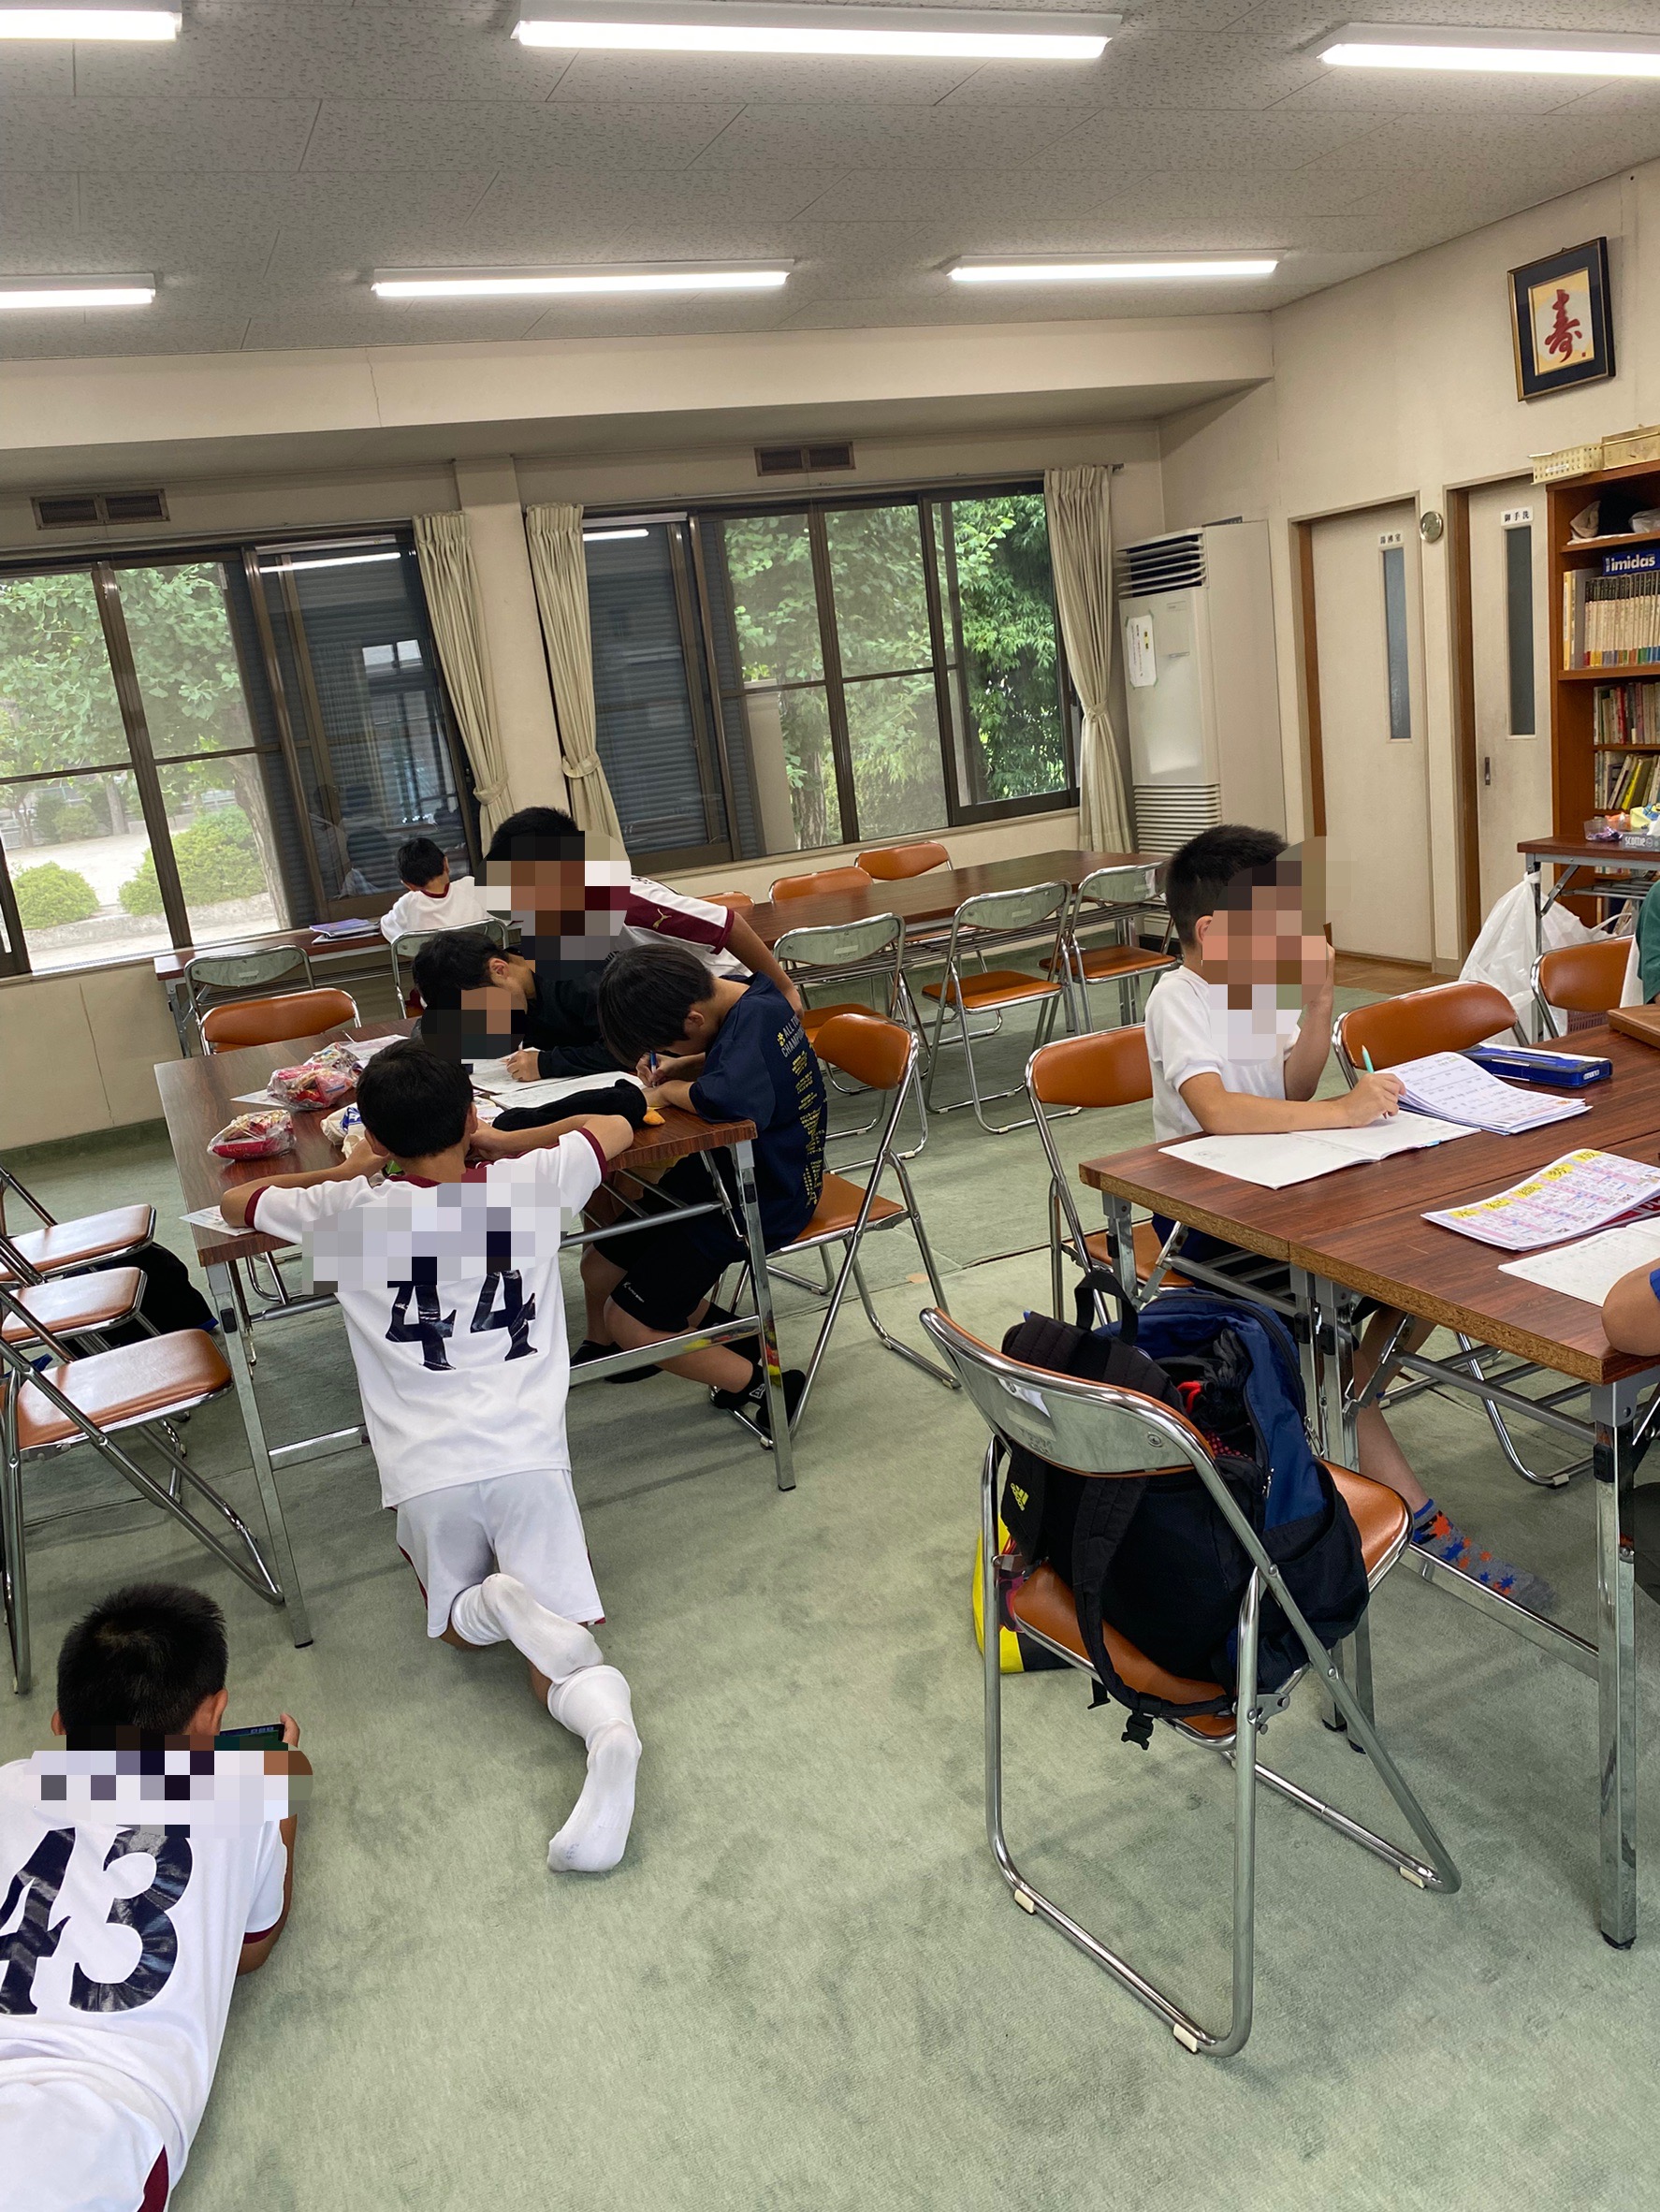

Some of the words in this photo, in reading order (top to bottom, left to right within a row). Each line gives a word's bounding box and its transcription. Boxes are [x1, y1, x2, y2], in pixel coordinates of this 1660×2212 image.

[1545, 289, 1582, 363] 寿
[1611, 554, 1655, 572] imidas
[386, 1254, 538, 1371] 44
[0, 1826, 194, 2014] 43
